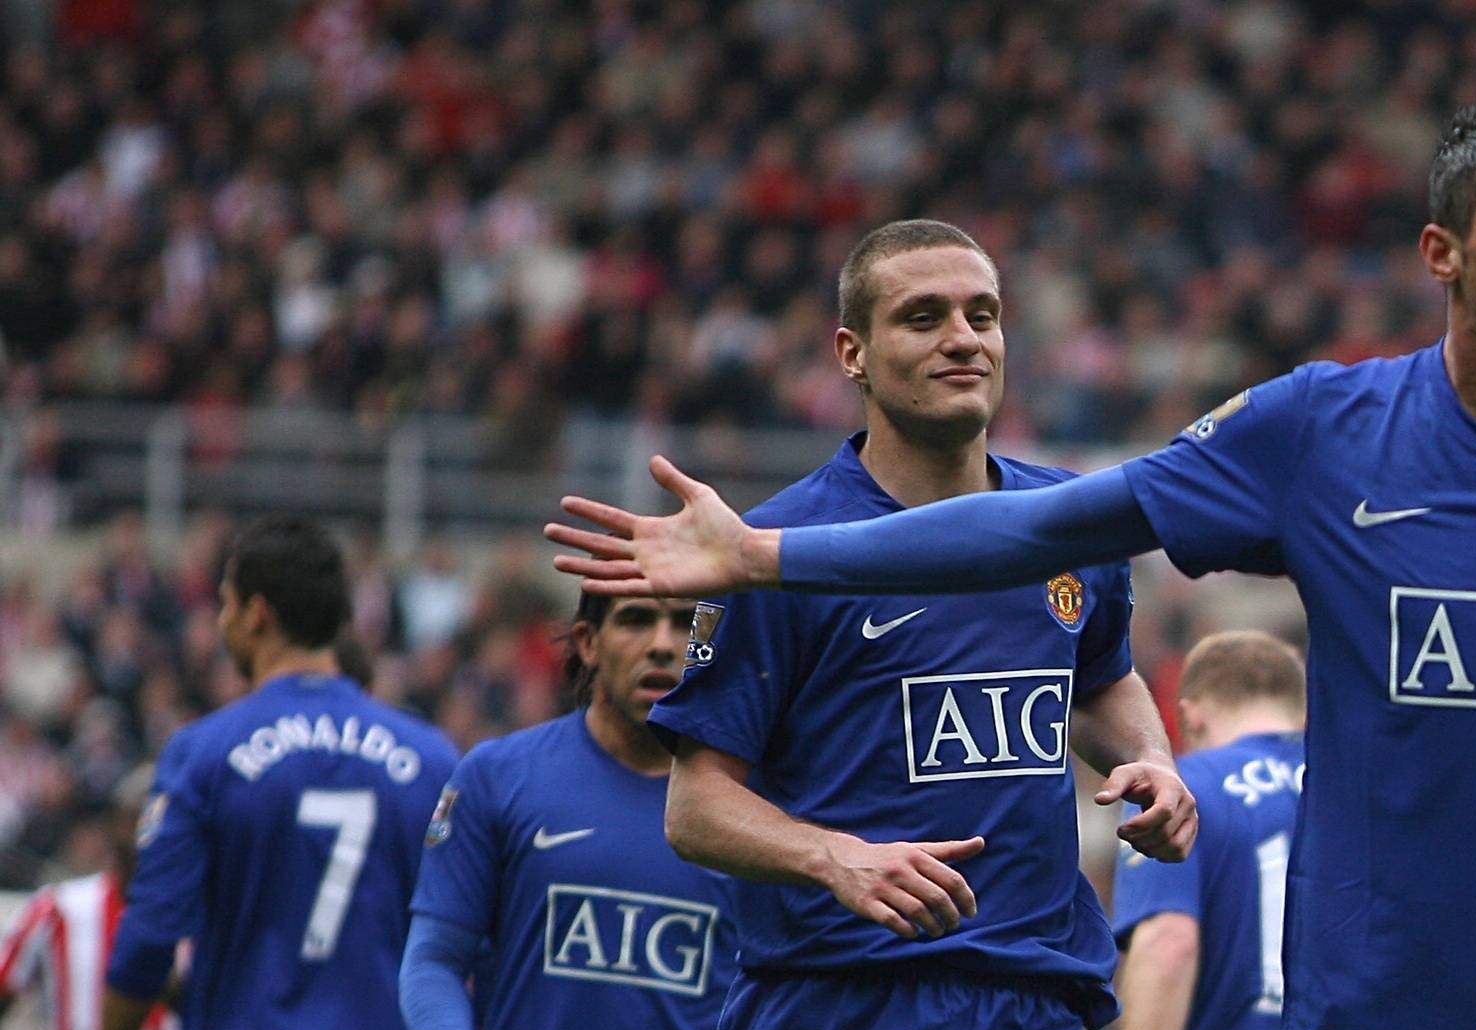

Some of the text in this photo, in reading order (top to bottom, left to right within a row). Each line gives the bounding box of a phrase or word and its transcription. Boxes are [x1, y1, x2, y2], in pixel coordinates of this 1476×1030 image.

[227, 713, 421, 784] RONALDO
[920, 683, 1065, 767] AIG
[297, 789, 377, 962] 7
[554, 897, 701, 981] AIG
